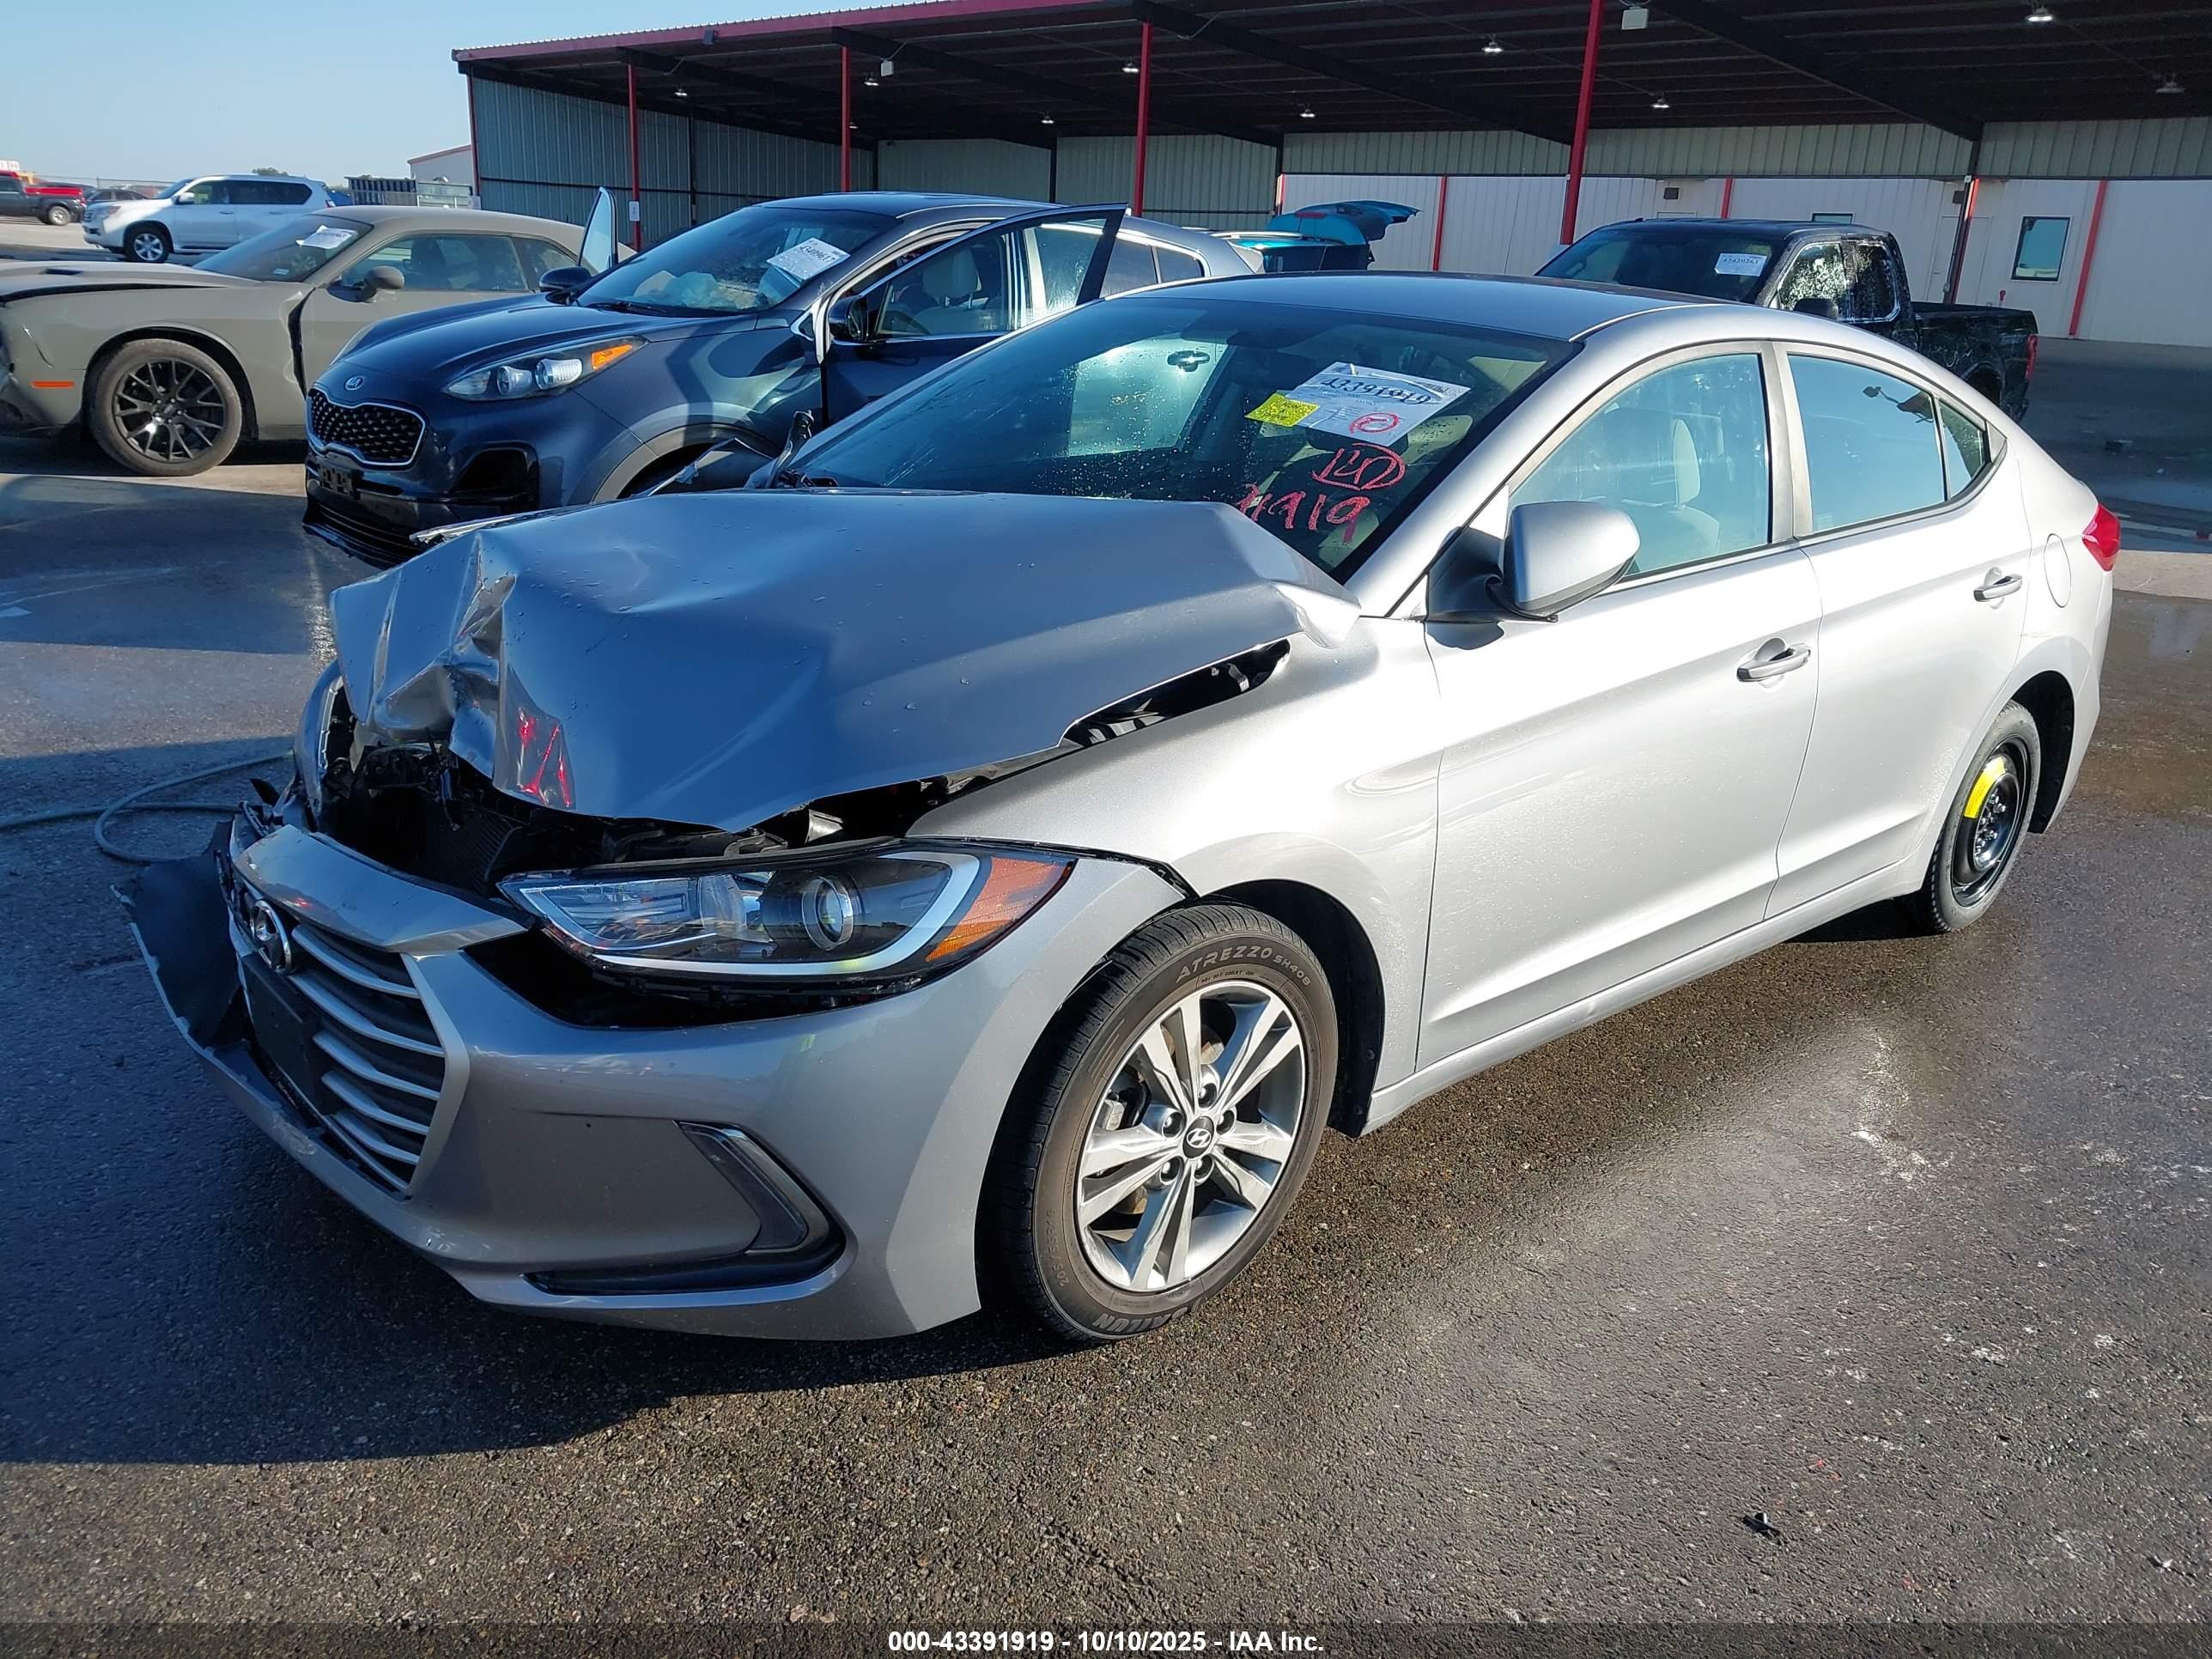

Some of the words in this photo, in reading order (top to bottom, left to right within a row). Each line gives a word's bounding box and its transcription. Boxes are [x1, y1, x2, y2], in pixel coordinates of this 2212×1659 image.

[1320, 376, 1432, 405] 43391919
[1175, 945, 1273, 984] ATREZZO
[1273, 953, 1311, 987] SH408
